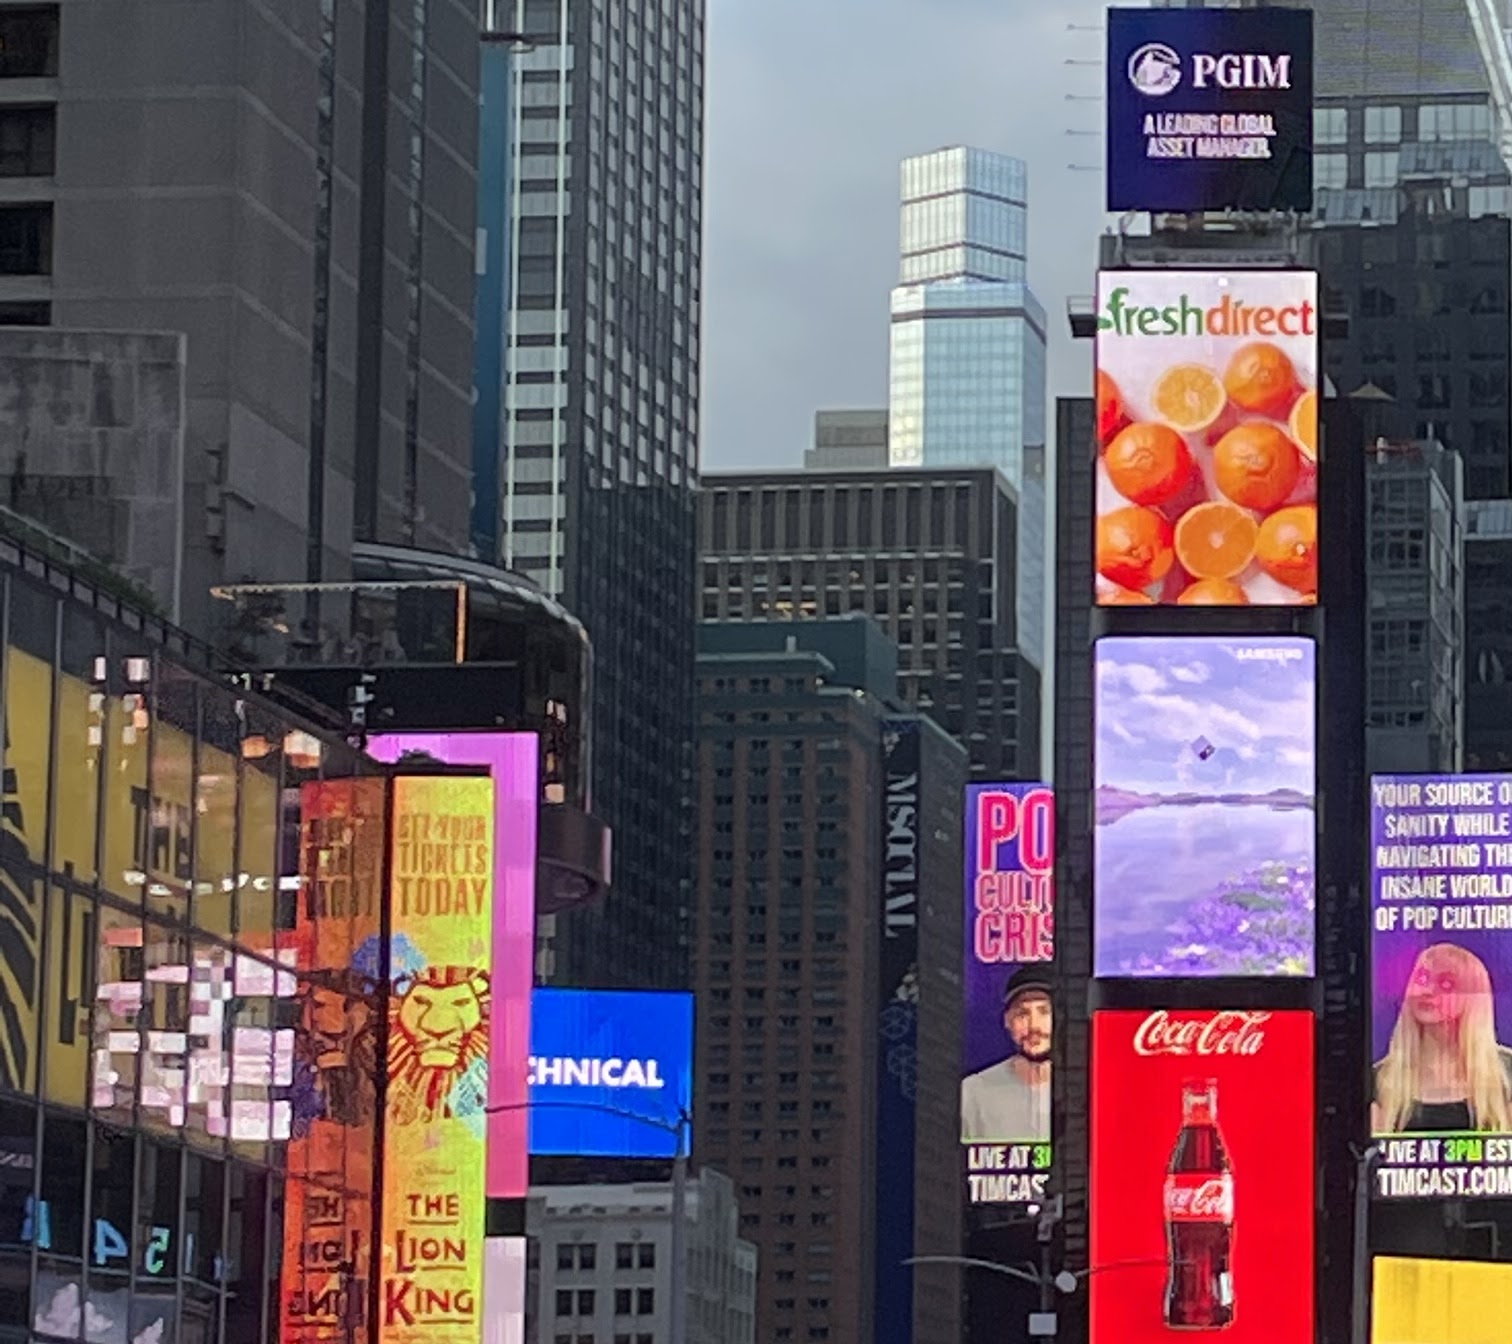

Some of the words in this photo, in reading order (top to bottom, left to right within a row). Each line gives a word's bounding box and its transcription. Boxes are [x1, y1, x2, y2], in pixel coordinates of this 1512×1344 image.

[1192, 55, 1292, 89] PGIM
[1143, 113, 1155, 135] A
[1156, 112, 1219, 136] LEADING
[1146, 137, 1194, 159] ASSET
[1196, 137, 1273, 159] MANAGER
[1099, 286, 1315, 337] freshdirect
[1373, 782, 1421, 808] YOUR
[1425, 782, 1494, 807] SOURCE
[1385, 813, 1450, 839] SANITY
[1453, 813, 1511, 837] WHILE
[399, 843, 488, 876] TICKETS
[1376, 843, 1480, 868] NAVIGATING
[398, 877, 488, 917] TODAY
[974, 873, 1055, 911] CULT
[1381, 874, 1447, 900] INSANE
[1375, 907, 1398, 931] OF
[1403, 906, 1439, 931] POP
[967, 1147, 1006, 1170] LIVE
[1009, 1146, 1030, 1169] AT
[1031, 1145, 1053, 1169] 3
[1419, 1139, 1442, 1163] AT
[1443, 1138, 1482, 1163] 3PM
[405, 1192, 460, 1217] THE
